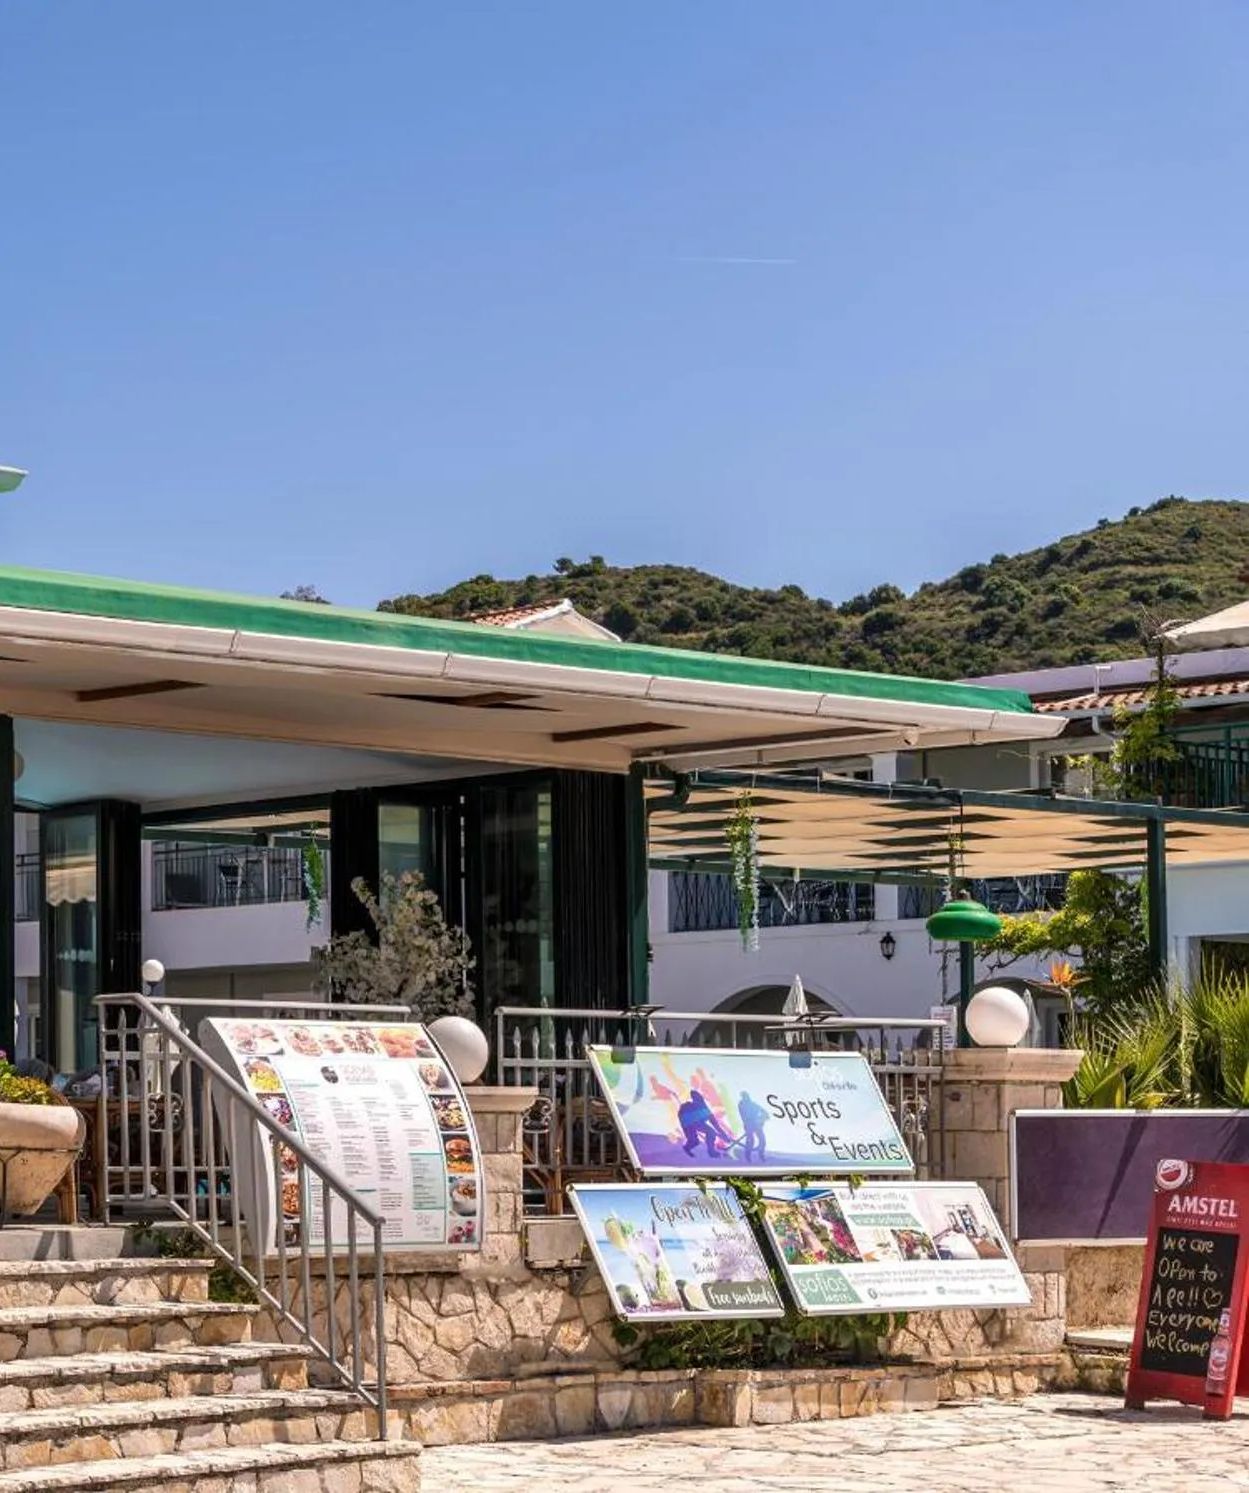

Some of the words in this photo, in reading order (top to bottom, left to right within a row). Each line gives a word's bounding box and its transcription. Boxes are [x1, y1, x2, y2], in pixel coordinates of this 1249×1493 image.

[766, 1094, 841, 1125] Sports
[807, 1122, 828, 1145] &
[828, 1136, 903, 1160] Events
[1168, 1194, 1238, 1217] AMSTEL
[1163, 1234, 1186, 1252] We
[1198, 1263, 1218, 1281] to
